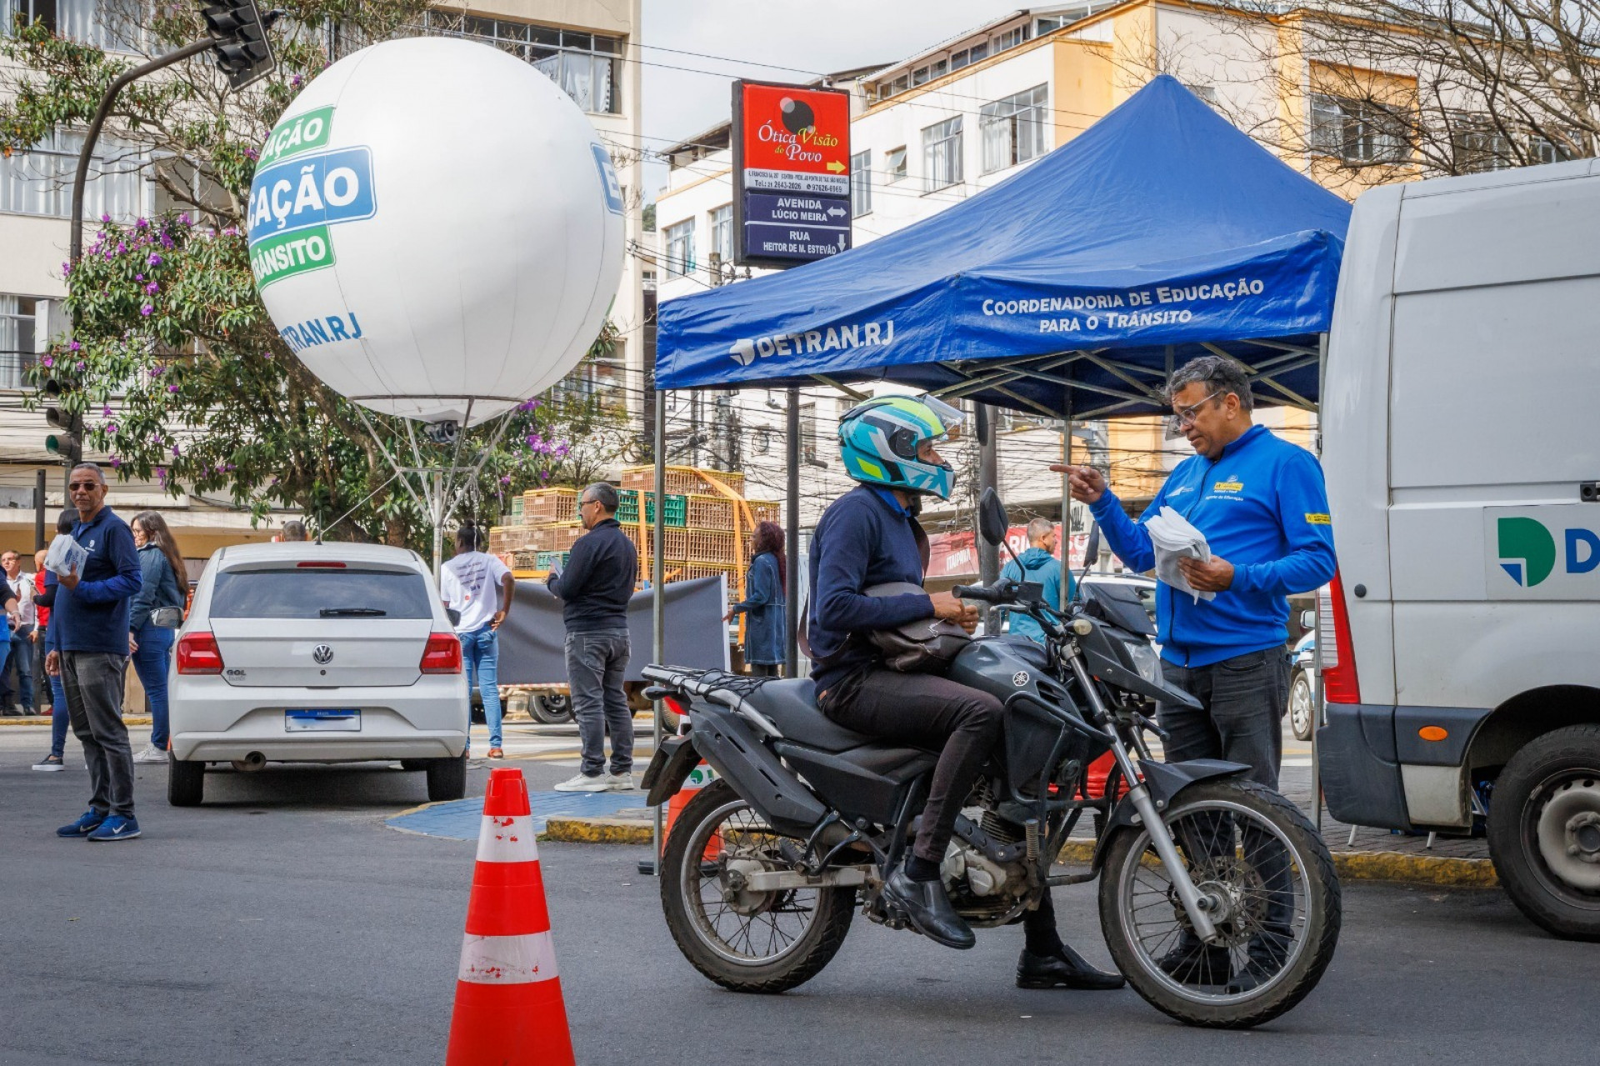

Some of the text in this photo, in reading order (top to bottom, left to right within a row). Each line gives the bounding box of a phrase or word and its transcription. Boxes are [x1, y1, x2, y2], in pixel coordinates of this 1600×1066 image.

[758, 119, 838, 147] Ótica Visão
[774, 143, 822, 163] do Povo
[771, 209, 828, 221] LÚCIO MEIRA
[777, 198, 822, 210] AVENIDA
[789, 230, 811, 241] RUA
[763, 241, 837, 255] HEITOR DE M. ESTEVÃO
[982, 278, 1264, 316] COORDENADORIA DE EDUCAÇÃO
[1039, 309, 1193, 333] PARA O TRÂNSITO
[754, 320, 894, 359] DETRAN.RJ
[1564, 528, 1600, 573] D
